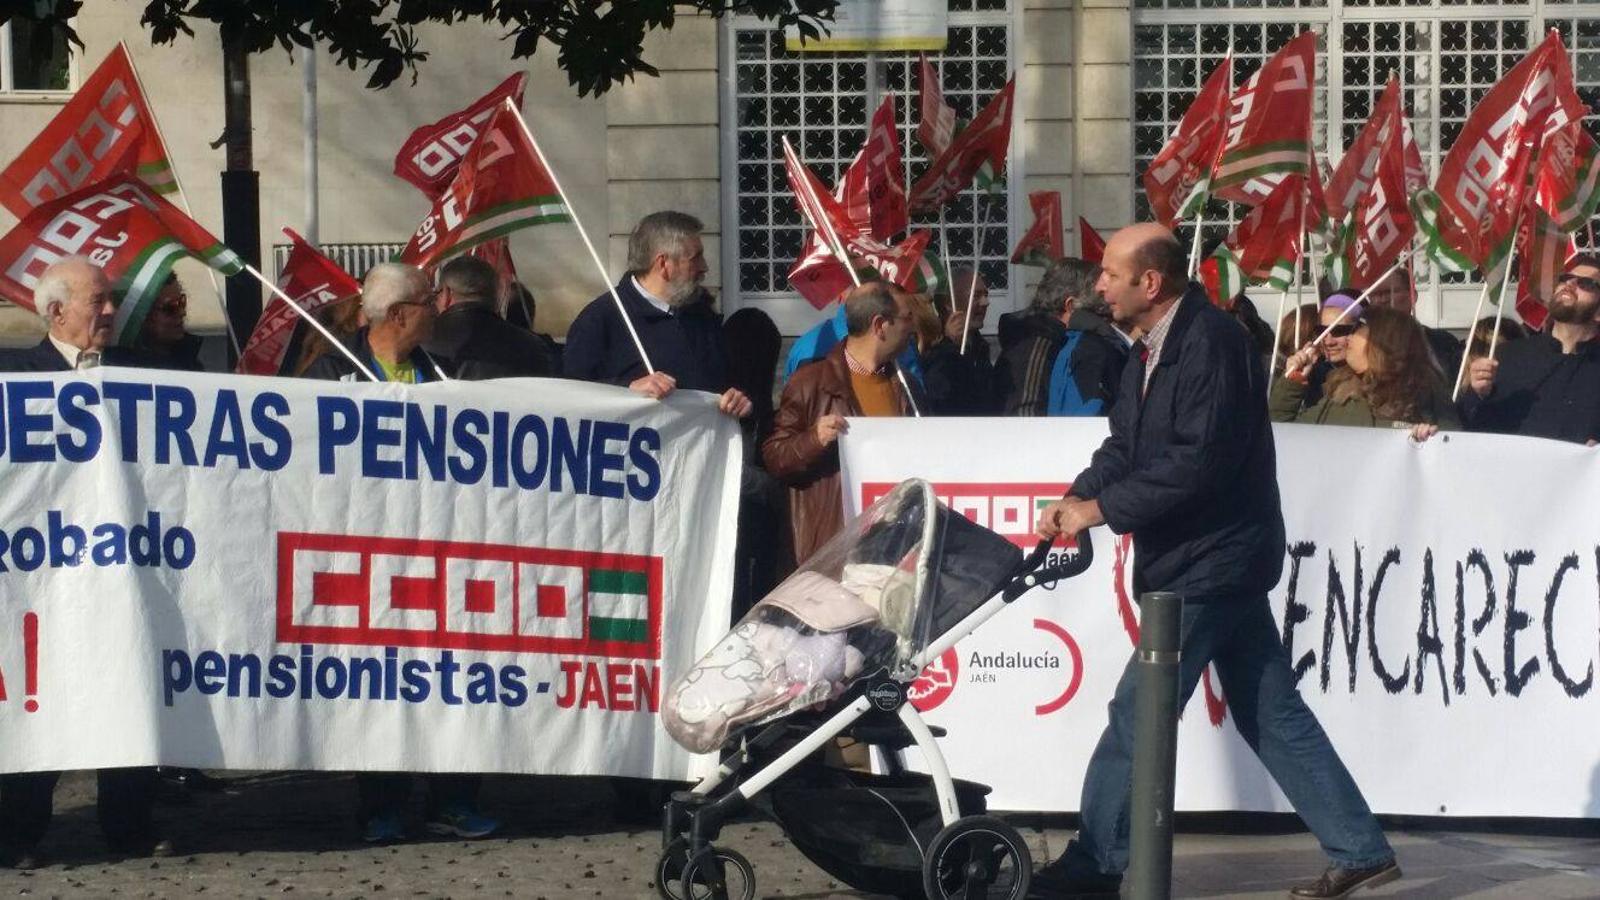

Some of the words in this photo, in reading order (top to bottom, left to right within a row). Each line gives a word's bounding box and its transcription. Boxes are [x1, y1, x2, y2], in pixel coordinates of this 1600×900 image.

[0, 380, 292, 471] ESTRAS
[317, 396, 661, 501] PENSIONES
[0, 510, 196, 572] obado
[291, 548, 584, 641] CCOO
[1282, 537, 1600, 707] ENCAREC
[969, 651, 1060, 669] Andalucía
